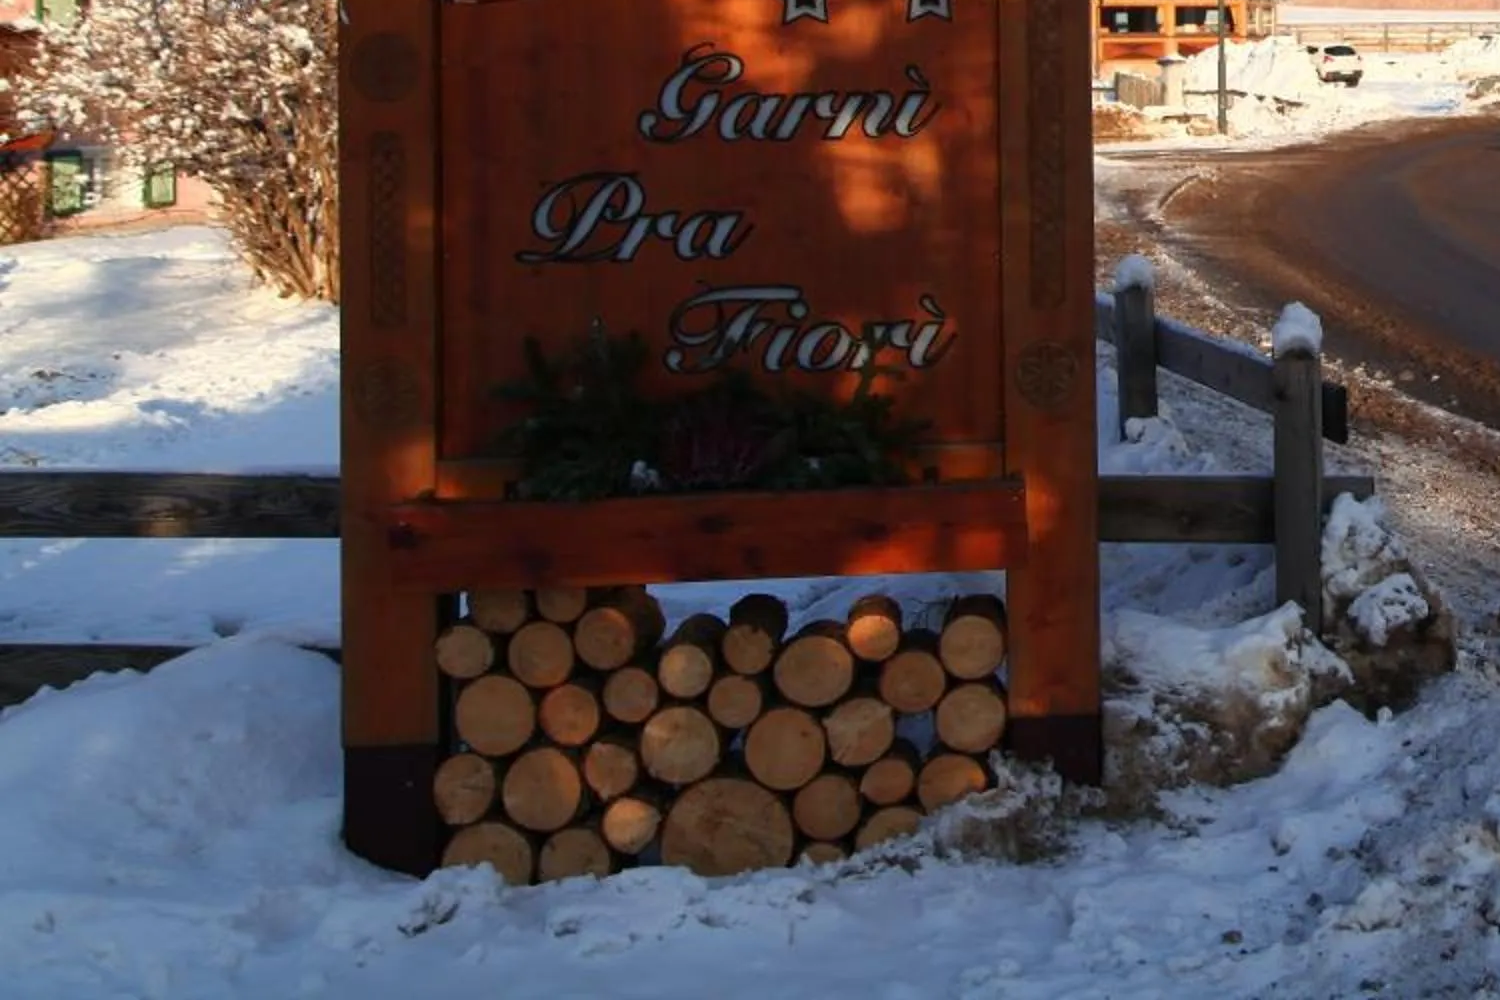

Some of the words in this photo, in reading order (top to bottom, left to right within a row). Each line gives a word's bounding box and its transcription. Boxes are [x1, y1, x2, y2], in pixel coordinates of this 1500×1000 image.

[637, 42, 940, 144] Garnì
[514, 171, 755, 265] Pra
[664, 281, 958, 374] Fiorì
